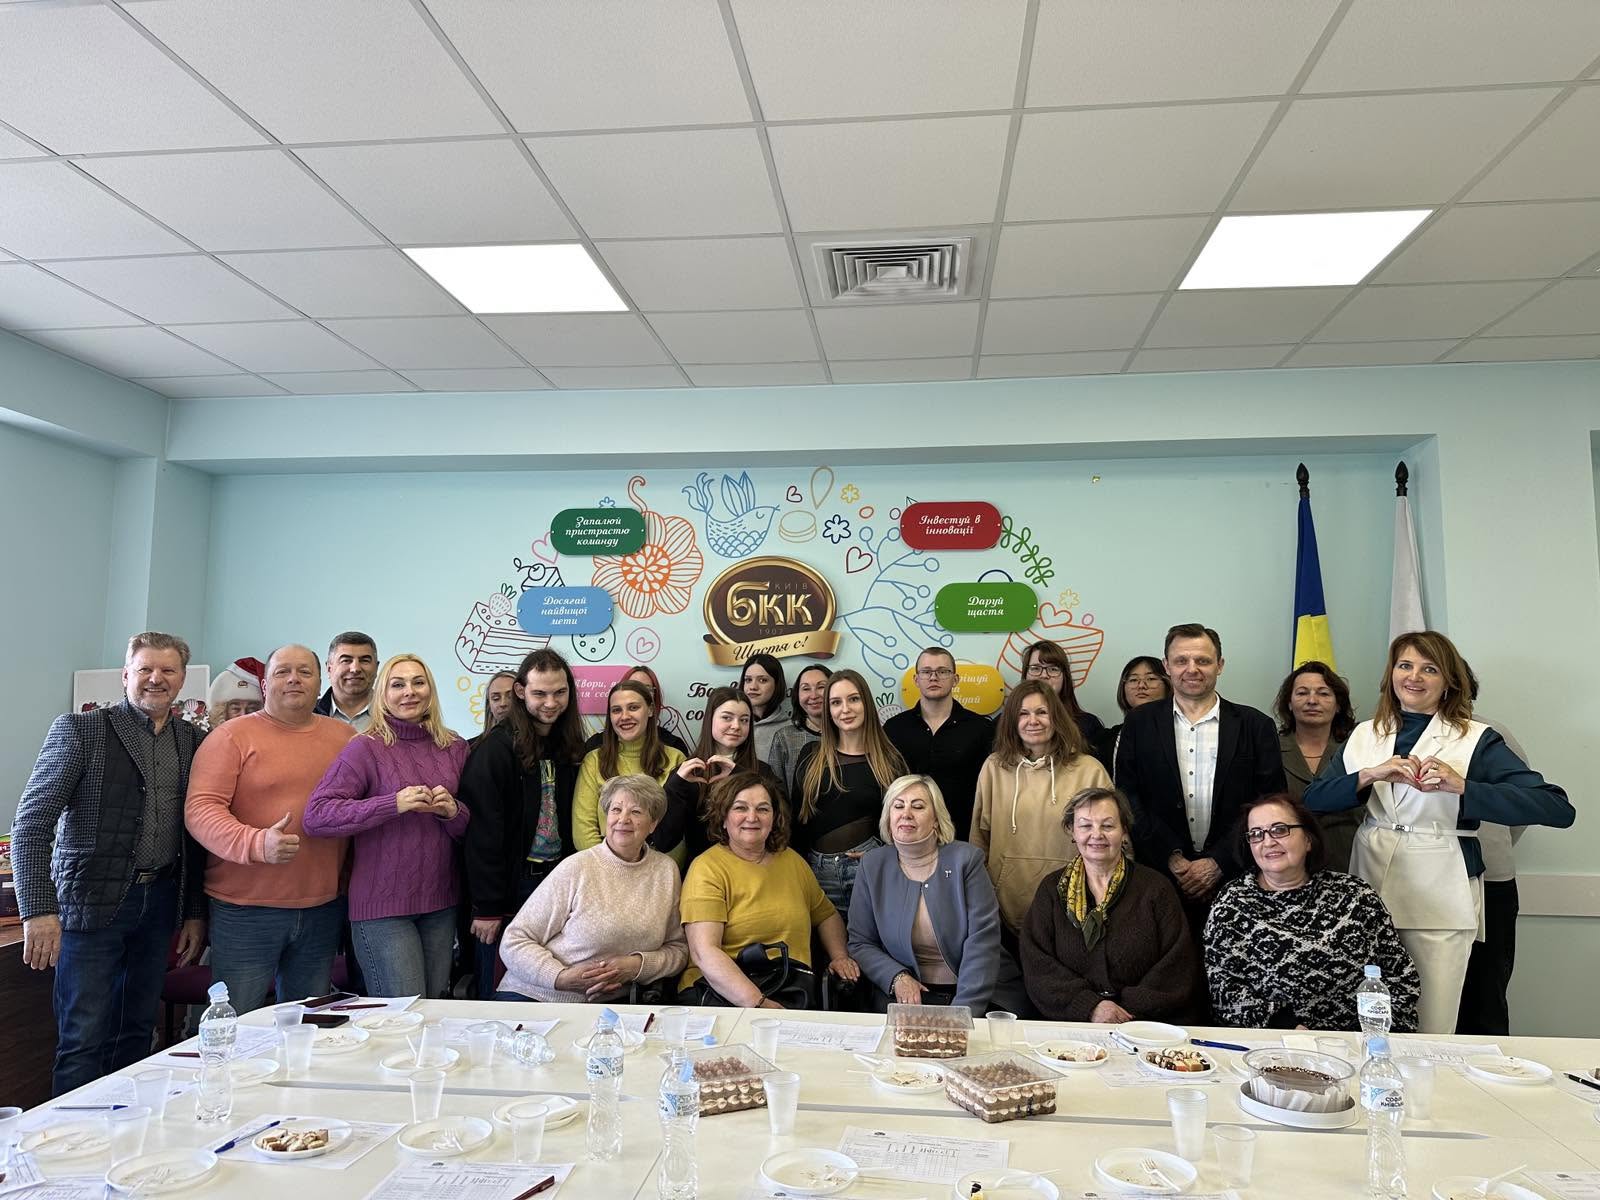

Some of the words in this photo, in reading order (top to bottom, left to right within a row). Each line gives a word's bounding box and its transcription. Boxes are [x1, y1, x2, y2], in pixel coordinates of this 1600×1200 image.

[575, 516, 622, 528] Запалюй
[918, 515, 971, 527] Інвестуй
[565, 528, 631, 538] пристрастю
[925, 525, 974, 536] інновації
[576, 538, 619, 548] команду
[543, 595, 587, 606] Досягай
[967, 595, 1004, 608] Даруй
[540, 606, 588, 617] найвищої
[967, 608, 1004, 619] щастя
[732, 643, 791, 661] Щастя
